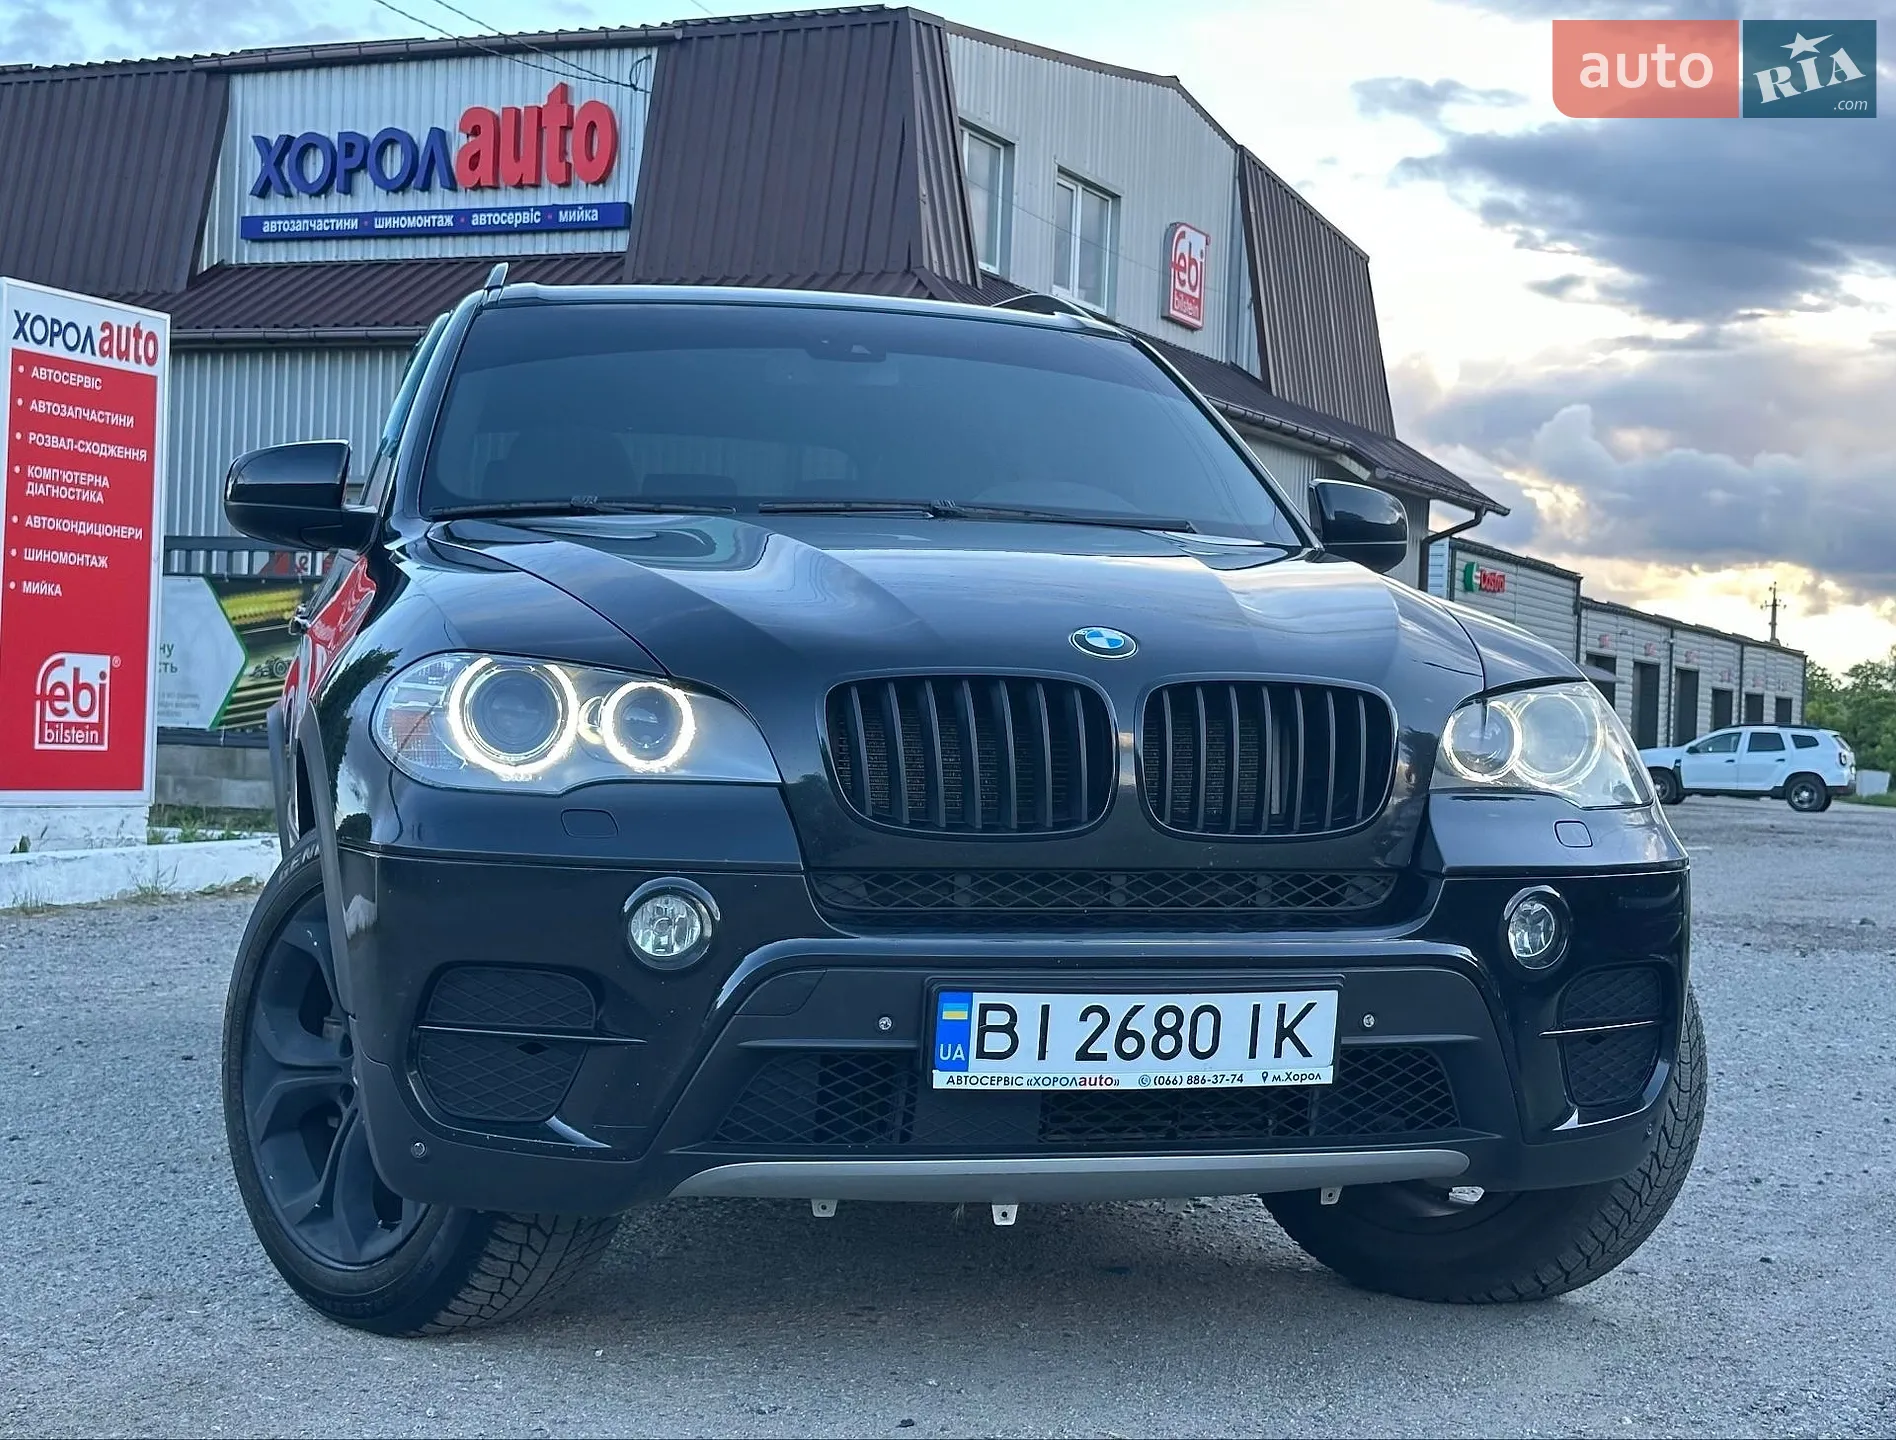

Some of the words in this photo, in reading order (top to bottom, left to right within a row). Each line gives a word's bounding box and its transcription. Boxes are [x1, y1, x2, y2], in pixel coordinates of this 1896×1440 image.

[262, 217, 359, 233] автозапчастини
[374, 213, 454, 230] шиномонтаж
[471, 208, 541, 226] автосервіс
[558, 207, 599, 223] мийка
[1170, 231, 1204, 292] febi
[31, 366, 103, 391] АВТОСЕРВІС
[29, 399, 134, 428] АВТОЗАПЧАСТИНИ
[28, 431, 148, 462] РОЗВАЛ-СХОДЖЕННЯ
[27, 464, 110, 489] КОМП'ЮТЕРНА
[26, 481, 105, 504] ДІАГНОСТИКА
[25, 514, 144, 541] АВТОКОНДИЦІОНЕРИ
[24, 547, 109, 569] ШИНОМОНТАЖ
[22, 580, 63, 597] МИЙКА
[37, 656, 108, 720] febi
[44, 722, 99, 744] bilstein
[975, 1003, 1051, 1061] BI
[1075, 1003, 1221, 1062] 2680
[1248, 1002, 1318, 1060] IK
[939, 1044, 966, 1061] UA
[946, 1075, 1024, 1087] АВТОСЕРВІС
[1153, 1075, 1183, 1086] (066)
[1186, 1074, 1244, 1085] 886-37-74
[1271, 1072, 1322, 1084] м.Хорол
